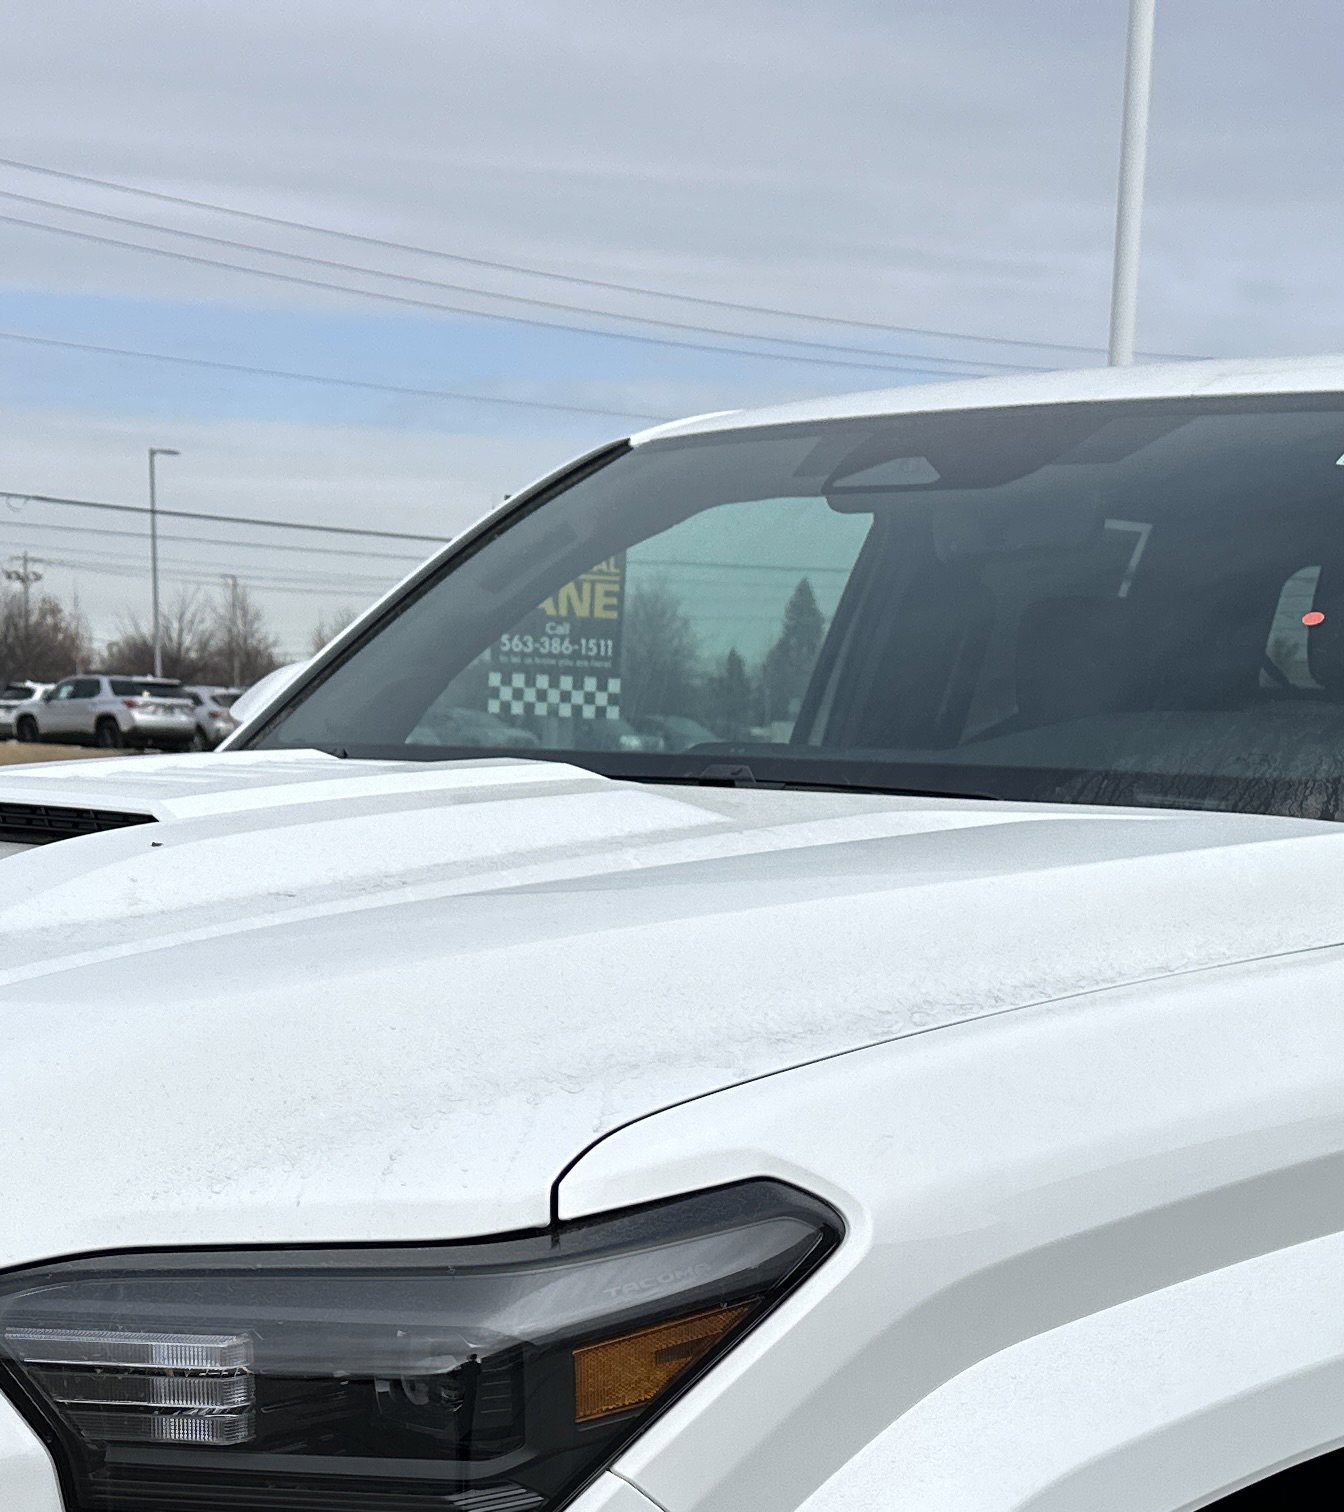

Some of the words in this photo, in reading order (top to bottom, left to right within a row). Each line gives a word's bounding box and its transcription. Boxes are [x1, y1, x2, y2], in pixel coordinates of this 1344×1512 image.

[545, 621, 571, 635] Call
[500, 633, 613, 657] 563-386-1511
[602, 1262, 712, 1297] TACOMA
